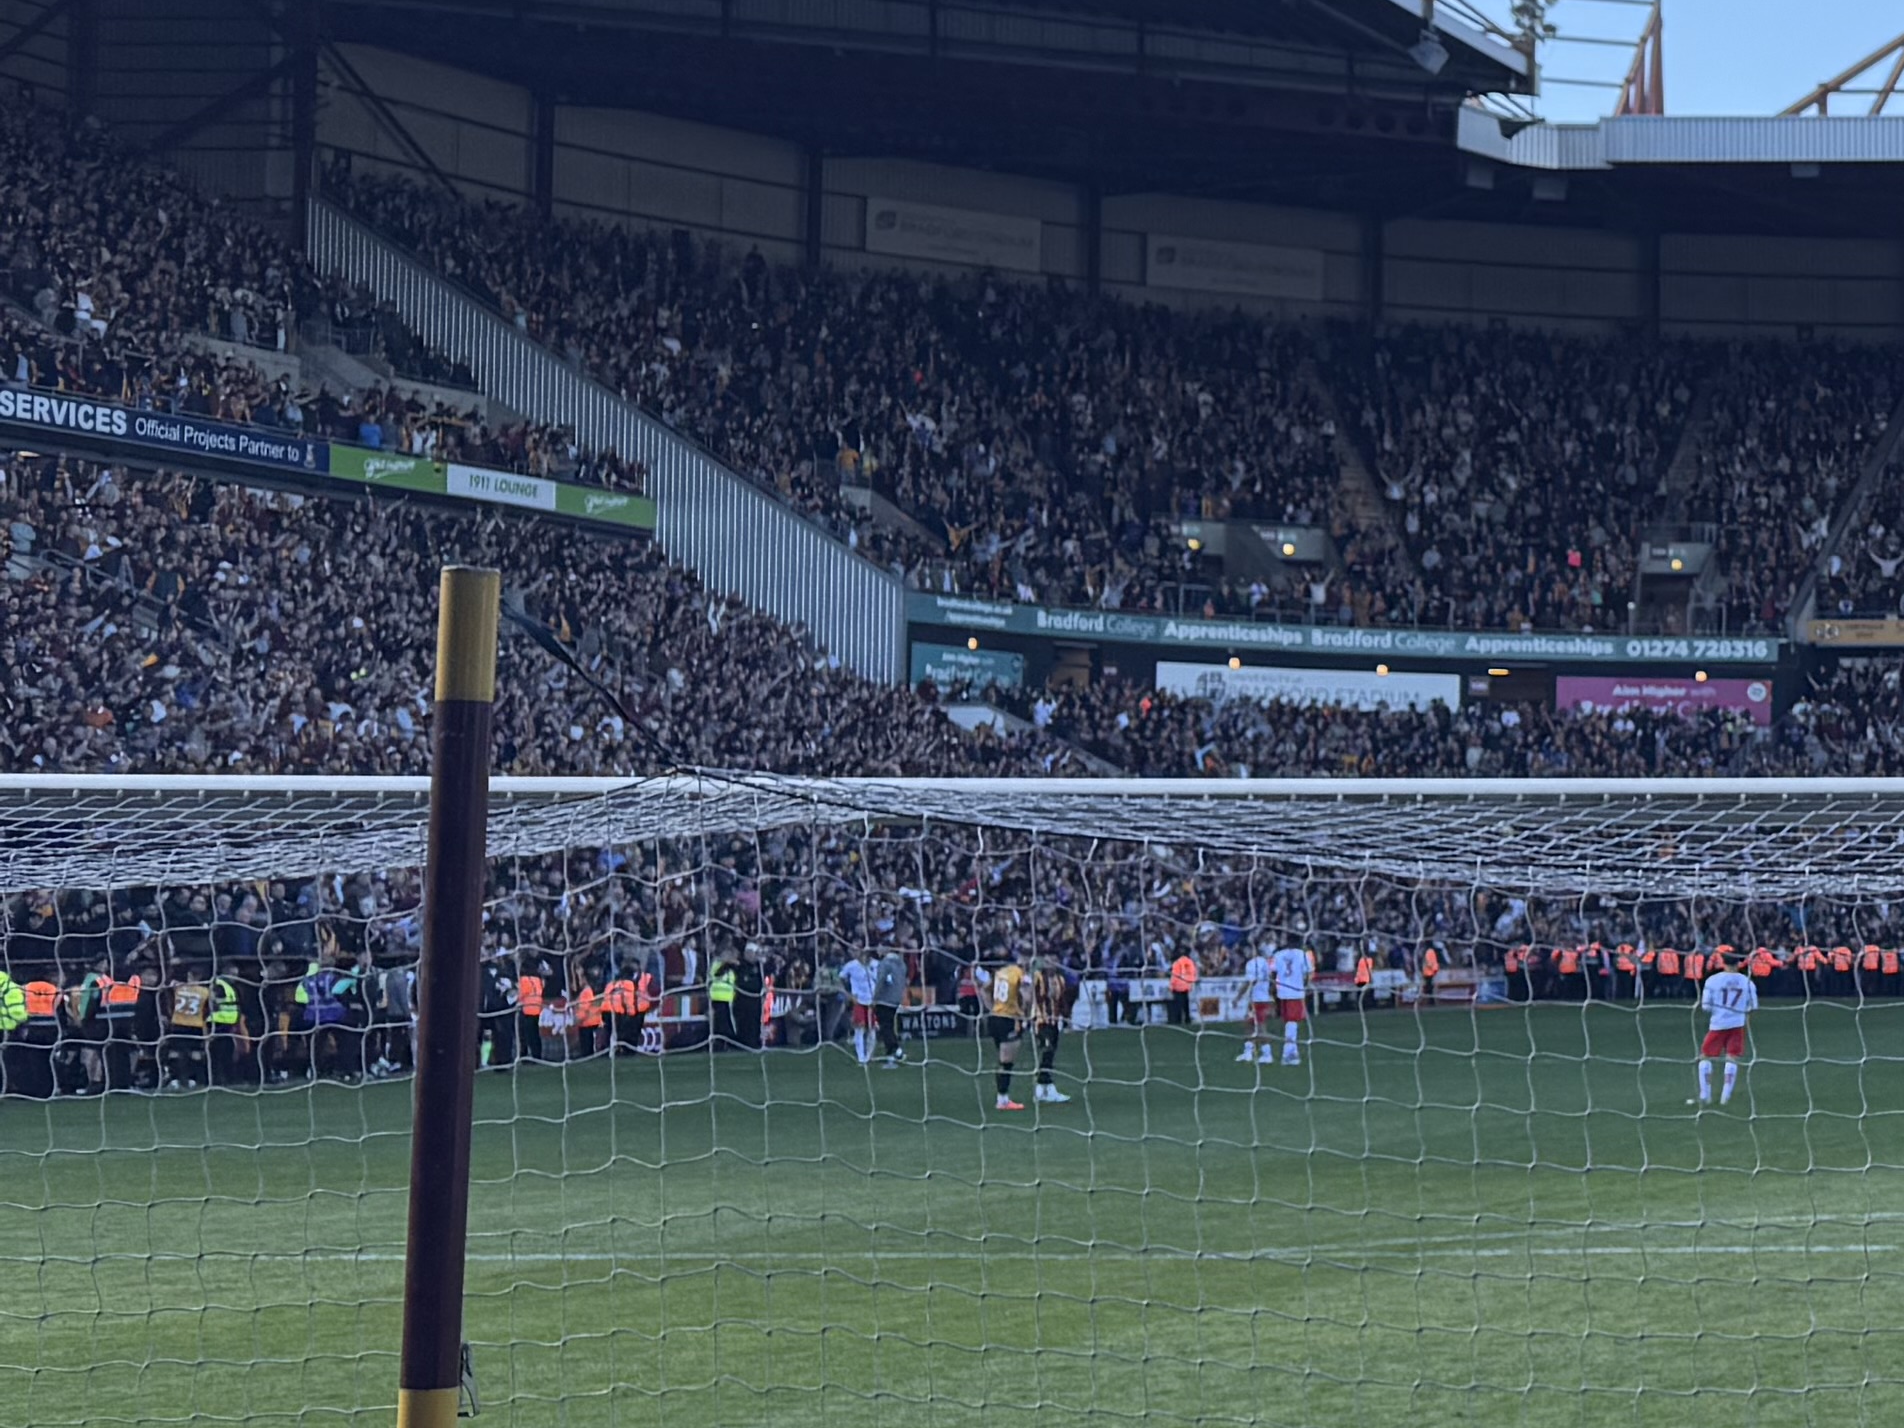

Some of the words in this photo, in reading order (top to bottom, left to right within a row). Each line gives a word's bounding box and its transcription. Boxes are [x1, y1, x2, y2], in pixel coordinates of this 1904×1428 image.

[0, 390, 127, 435] SERVICES
[135, 417, 180, 441] Official
[183, 424, 236, 452] Projects
[239, 435, 284, 460] Partner
[287, 442, 299, 461] to
[469, 473, 490, 491] 1911
[494, 477, 538, 499] LOUNGE
[1037, 611, 1104, 632] Bradford
[1106, 615, 1155, 641] College
[1164, 621, 1303, 646] Apprenticeships
[1311, 629, 1391, 649] Bradford
[1395, 632, 1456, 653] College
[1465, 635, 1613, 656] Apprenticeships
[1627, 639, 1688, 657] 01274
[1694, 639, 1768, 658] 728316
[1612, 684, 1638, 697] Aim
[1642, 684, 1687, 699] Higher
[1284, 959, 1294, 978] 3
[175, 996, 200, 1015] 23
[1721, 987, 1743, 1007] 17
